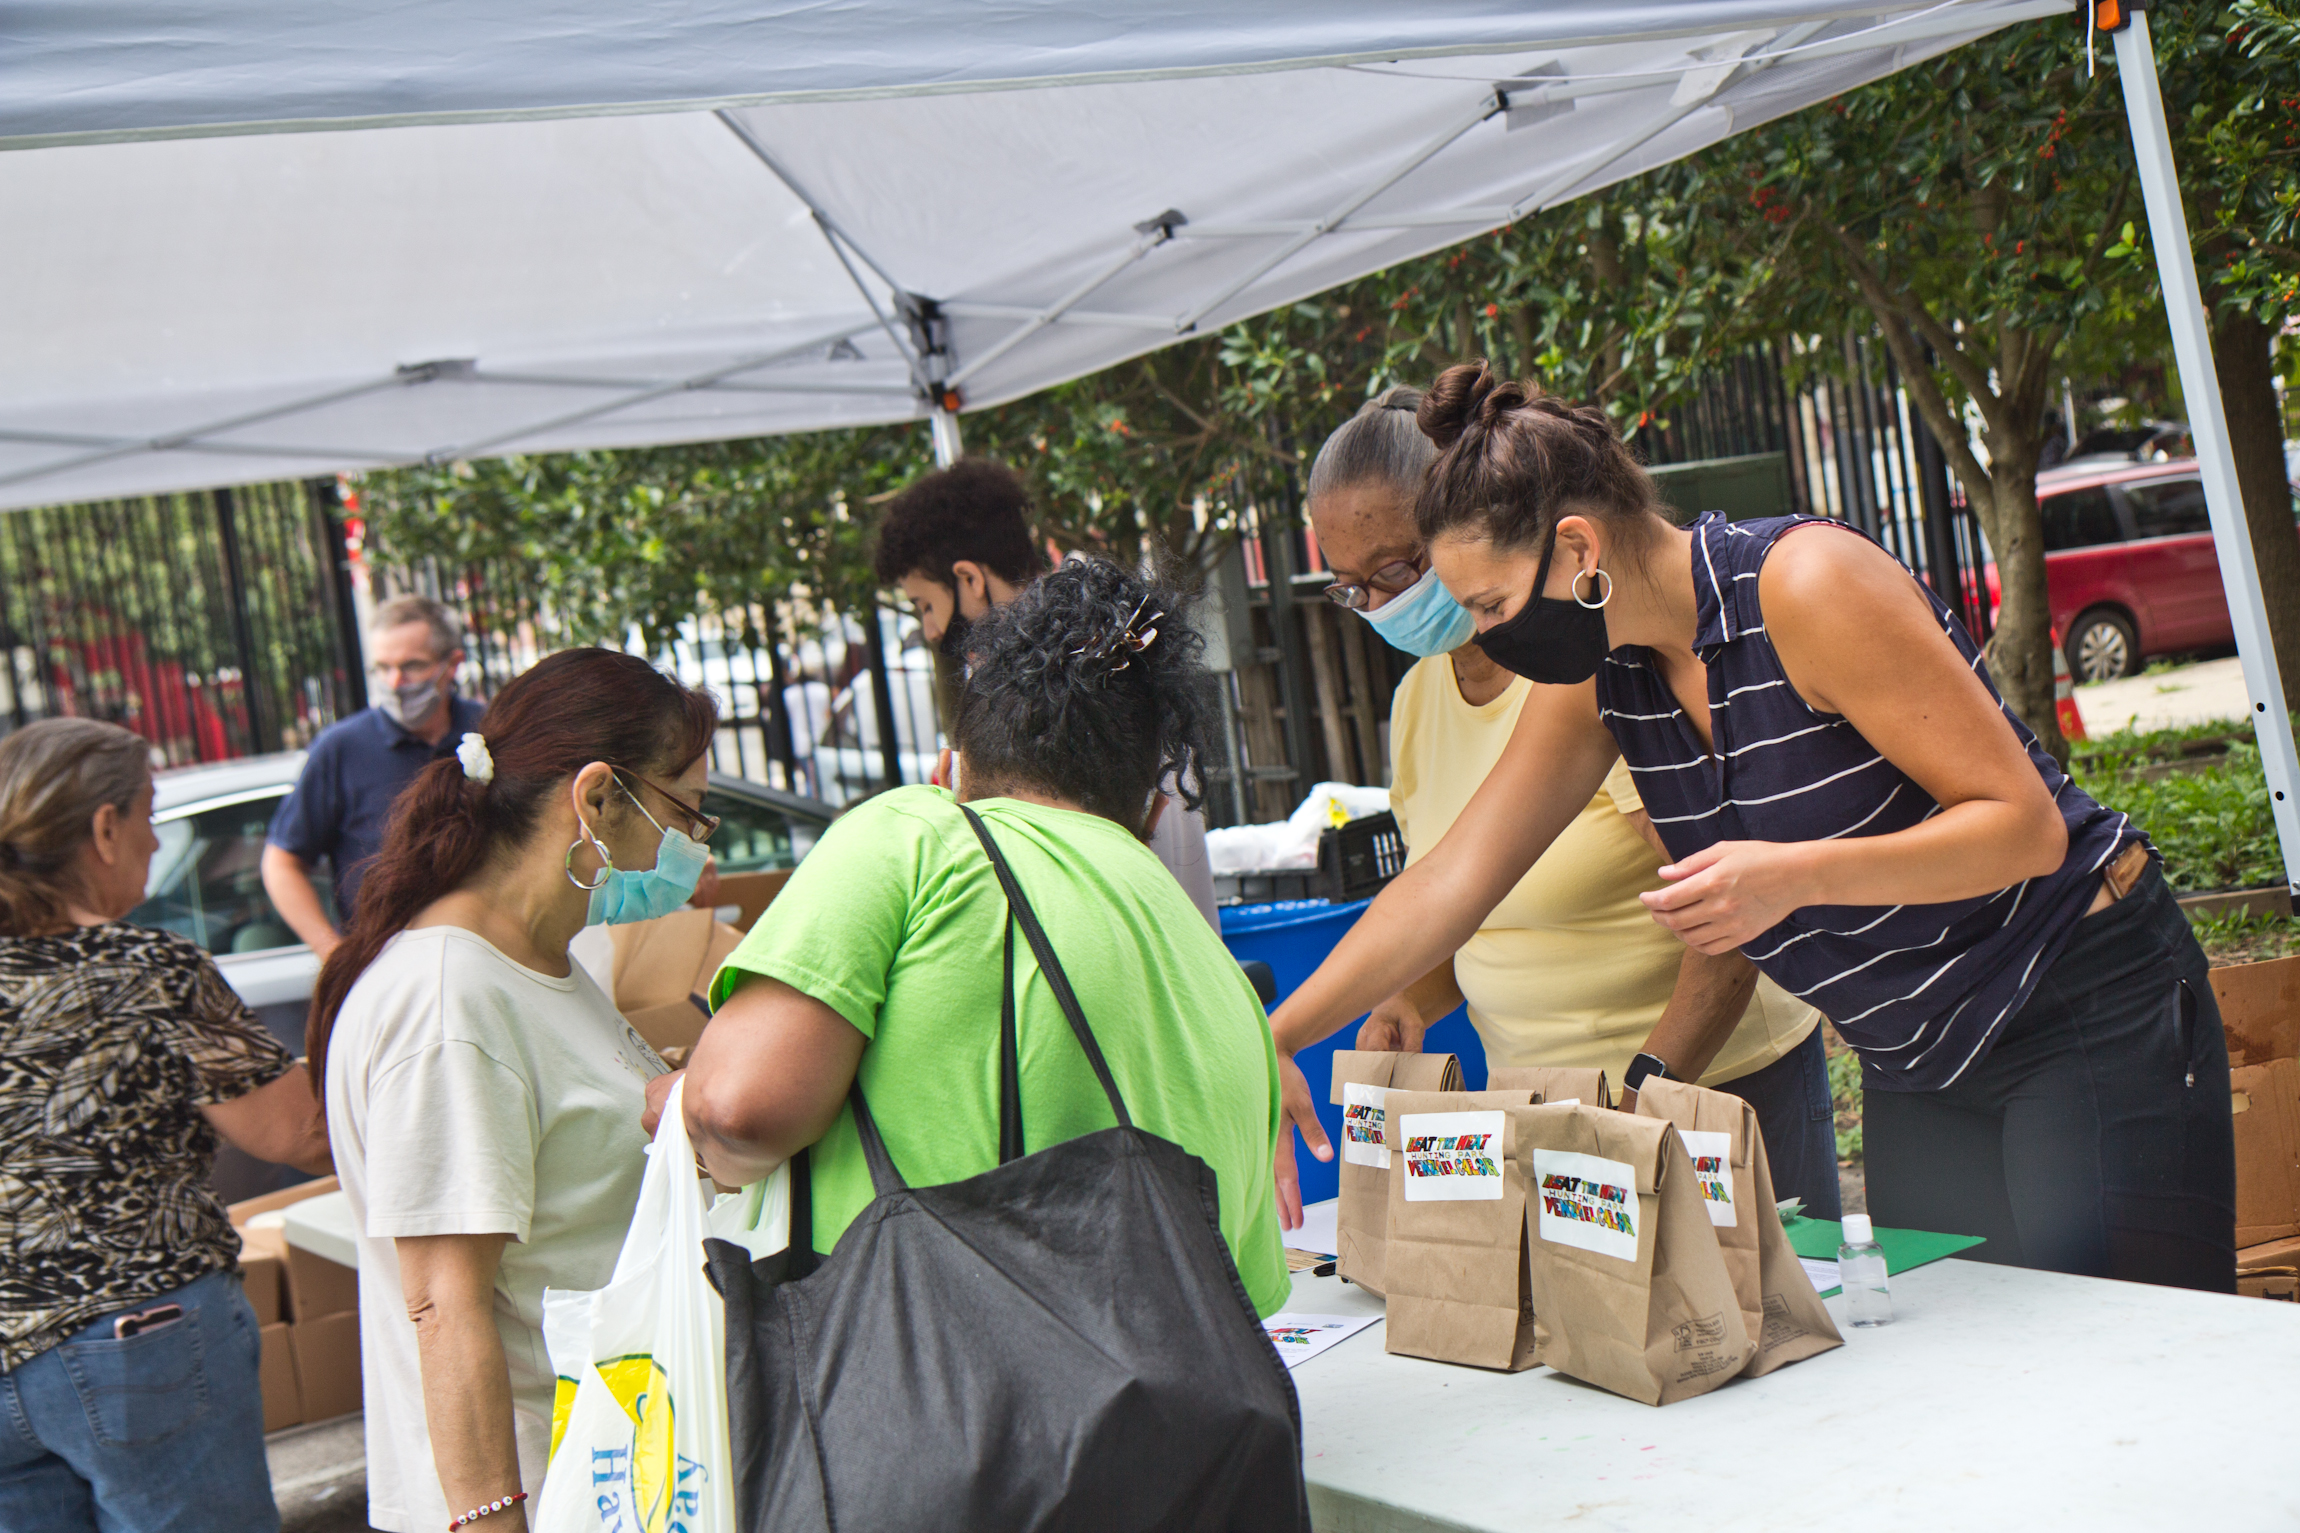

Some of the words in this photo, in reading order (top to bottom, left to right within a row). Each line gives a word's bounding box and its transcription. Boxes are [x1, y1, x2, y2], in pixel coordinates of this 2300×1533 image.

[1347, 1119, 1383, 1129] HUNTING
[1406, 1136, 1437, 1152] BEAT
[1437, 1137, 1458, 1150] THE
[1455, 1134, 1492, 1150] HEAT
[1411, 1151, 1451, 1159] HUNTING
[1457, 1150, 1485, 1158] PARK
[1455, 1157, 1500, 1177] CALOR
[1697, 1156, 1721, 1173] HEAT
[1698, 1172, 1717, 1180] PARK
[1542, 1174, 1582, 1192] BEAT
[1581, 1180, 1600, 1196] THE
[1599, 1184, 1628, 1204] HEAT
[1549, 1189, 1595, 1205] HUNTING
[1601, 1199, 1625, 1212] PARK
[1597, 1207, 1635, 1237] CALOR
[667, 1453, 708, 1533] ay
